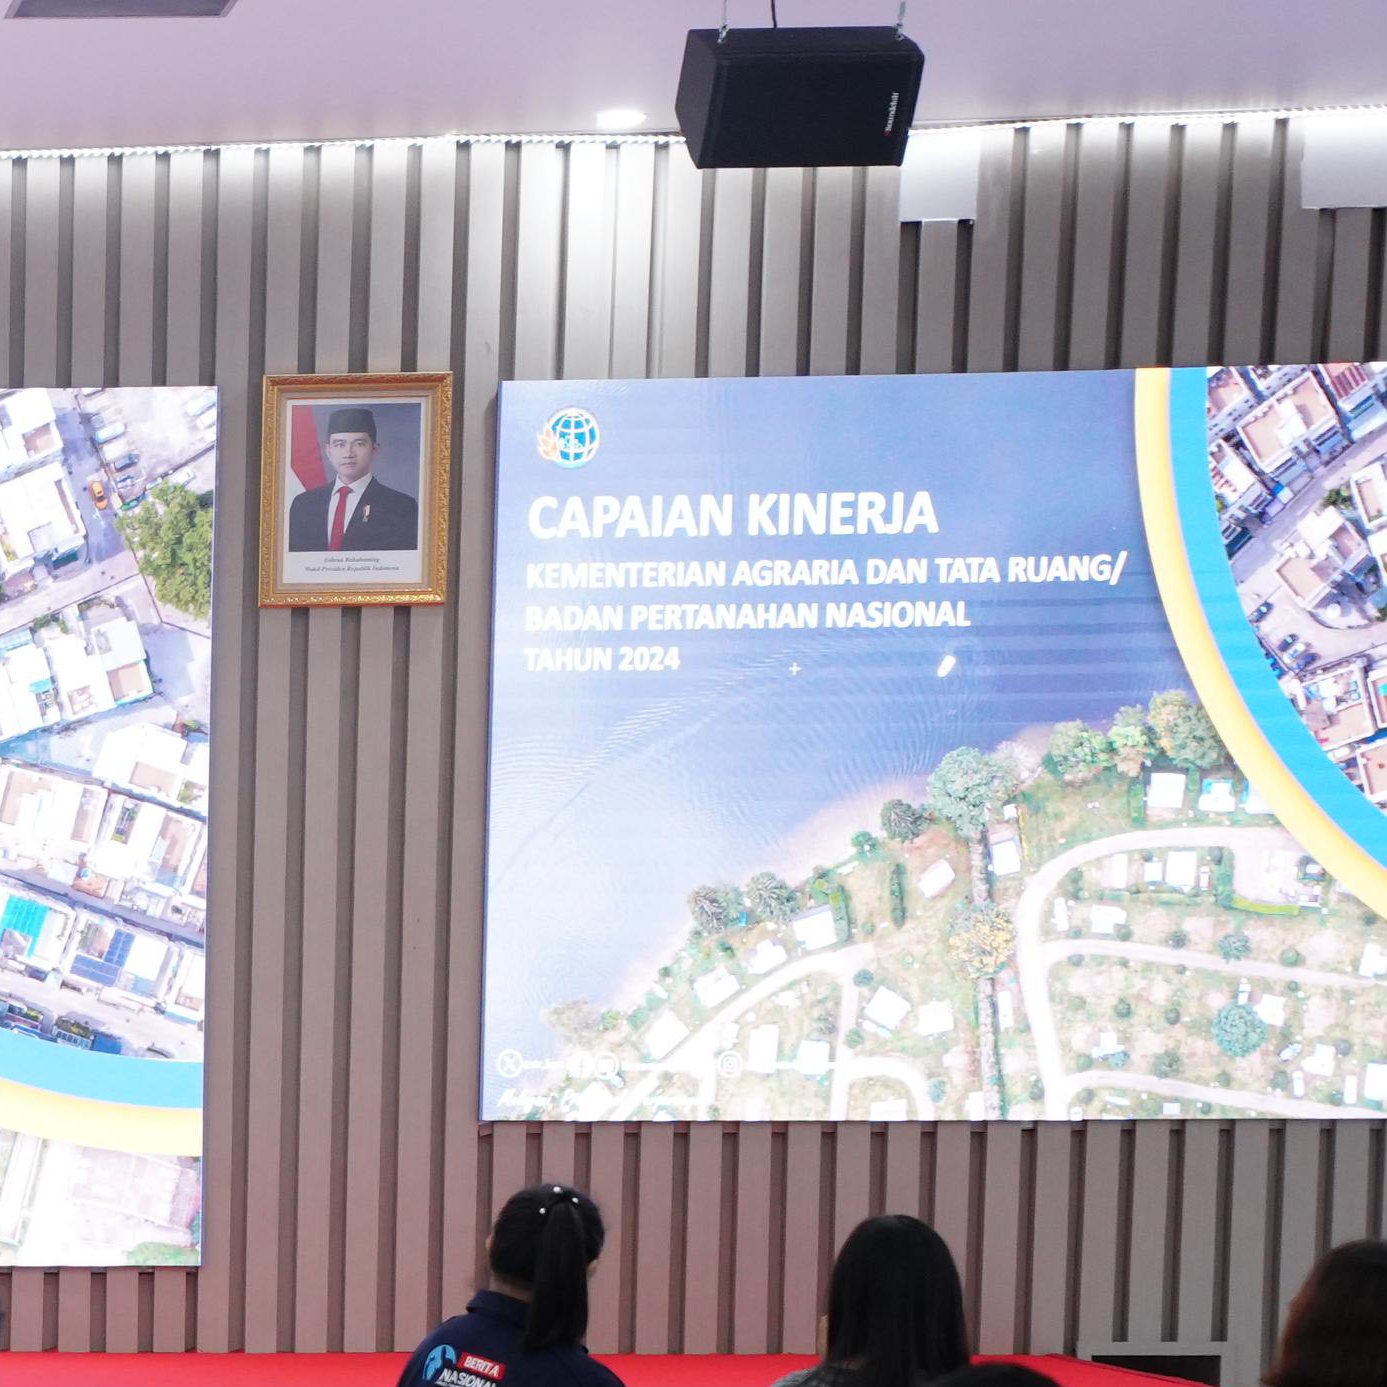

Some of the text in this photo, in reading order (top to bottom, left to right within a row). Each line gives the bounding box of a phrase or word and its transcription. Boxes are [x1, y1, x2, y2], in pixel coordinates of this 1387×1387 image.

[528, 491, 940, 540] CAPAIAN KINERJA
[526, 550, 1128, 590] KEMENTERIAN AGRARIA DAN TATA RUANG/
[524, 600, 972, 632] BADAN PERTANAHAN NASIONAL
[524, 645, 681, 673] TAHUN 2024
[463, 1356, 500, 1377] BERITA
